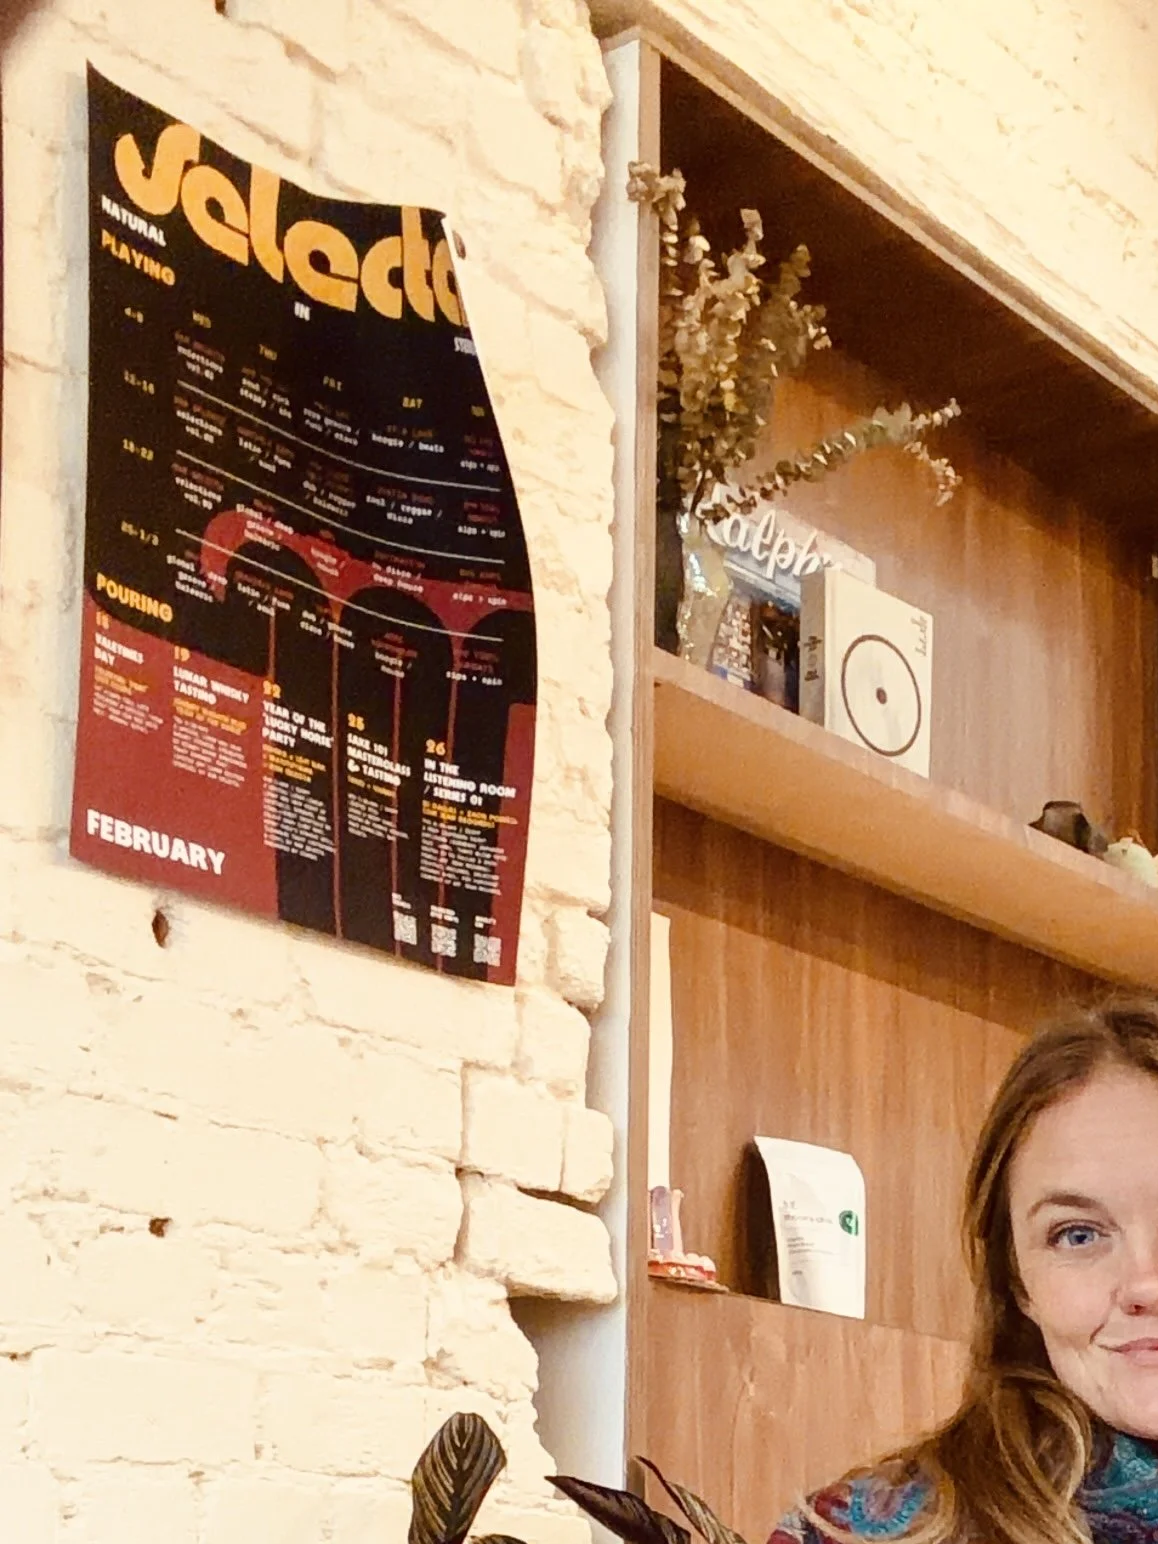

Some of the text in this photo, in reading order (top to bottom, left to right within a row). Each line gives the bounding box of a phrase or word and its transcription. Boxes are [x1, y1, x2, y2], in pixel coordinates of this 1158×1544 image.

[101, 194, 166, 247] NATURAL
[102, 228, 175, 286] PLAYING
[294, 301, 311, 321] IN
[323, 376, 342, 391] FRI
[402, 397, 423, 408] SAT
[96, 572, 174, 623] POURING
[94, 645, 116, 667] DAY
[173, 665, 208, 689] LUNAR
[210, 679, 249, 704] WHISKY
[173, 679, 217, 706] TASTING
[263, 680, 281, 699] 22
[263, 699, 289, 720] YEAR
[292, 710, 305, 725] OF
[308, 717, 327, 733] THE
[262, 727, 296, 748] PARTY
[347, 733, 388, 756] SAKE 101
[425, 738, 446, 755] 26
[347, 745, 411, 778] MASTERCLASS
[347, 758, 360, 773] &
[362, 764, 401, 786] TASTING
[424, 758, 460, 776] IN THE
[424, 771, 517, 798] LISTENING ROOM
[433, 787, 466, 803] SERIES
[470, 794, 483, 806] 01
[87, 809, 226, 875] FEBRUARY
